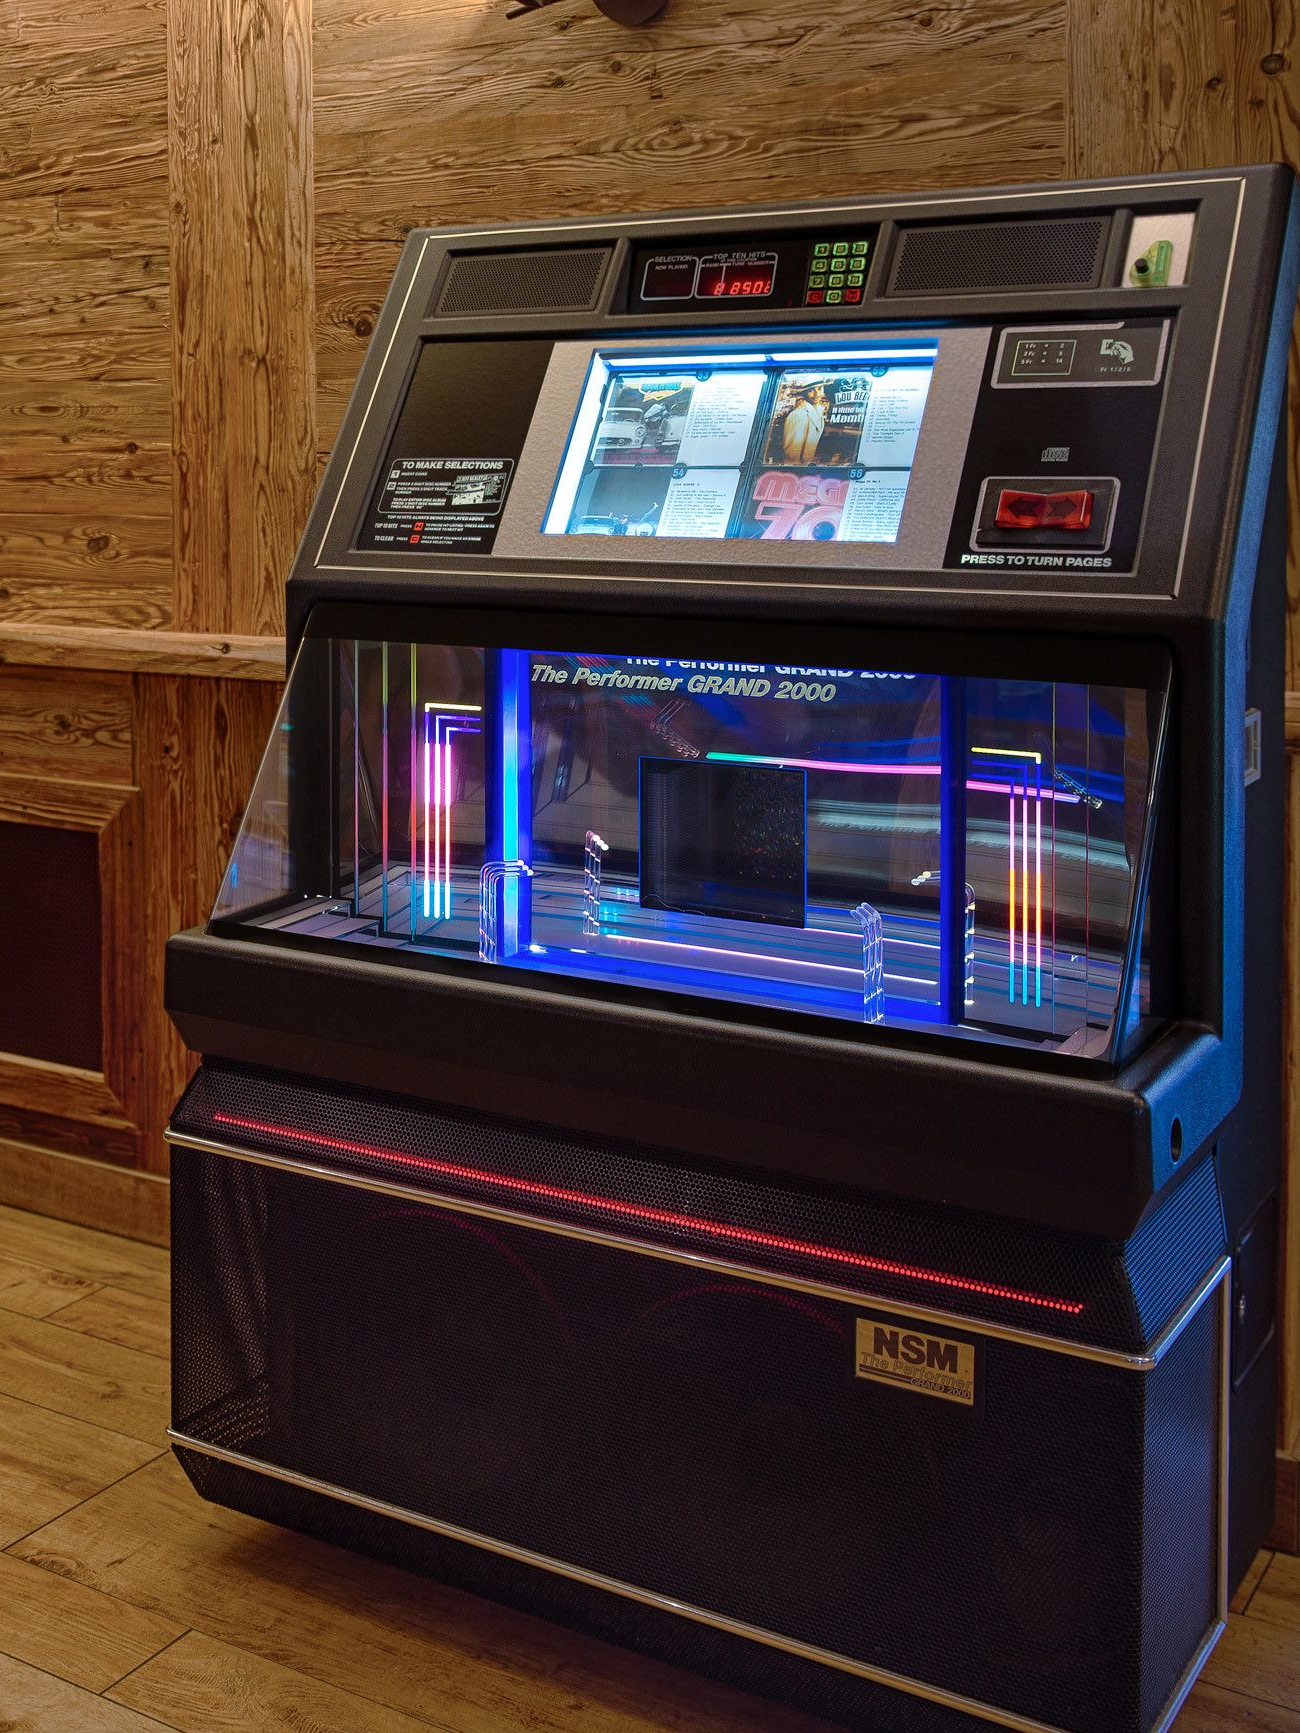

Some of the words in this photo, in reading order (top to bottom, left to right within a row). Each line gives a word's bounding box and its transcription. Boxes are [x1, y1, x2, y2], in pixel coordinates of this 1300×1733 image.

[836, 392, 852, 403] LOU
[416, 461, 444, 469] MAKE
[444, 461, 504, 470] SELECTIONS
[672, 468, 684, 477] 54
[850, 468, 863, 478] 56
[961, 554, 1005, 564] PRESS
[1006, 556, 1025, 565] TO
[1026, 556, 1063, 566] TURN
[1066, 557, 1112, 568] PAGES
[530, 664, 567, 684] The
[572, 666, 684, 692] Performer
[687, 674, 771, 698] GRAND
[774, 682, 837, 702] 2000
[873, 1326, 958, 1374] NSM
[860, 1351, 889, 1369] The
[893, 1360, 973, 1390] Performer
[909, 1376, 946, 1392] GRAND
[948, 1386, 971, 1400] 2000
